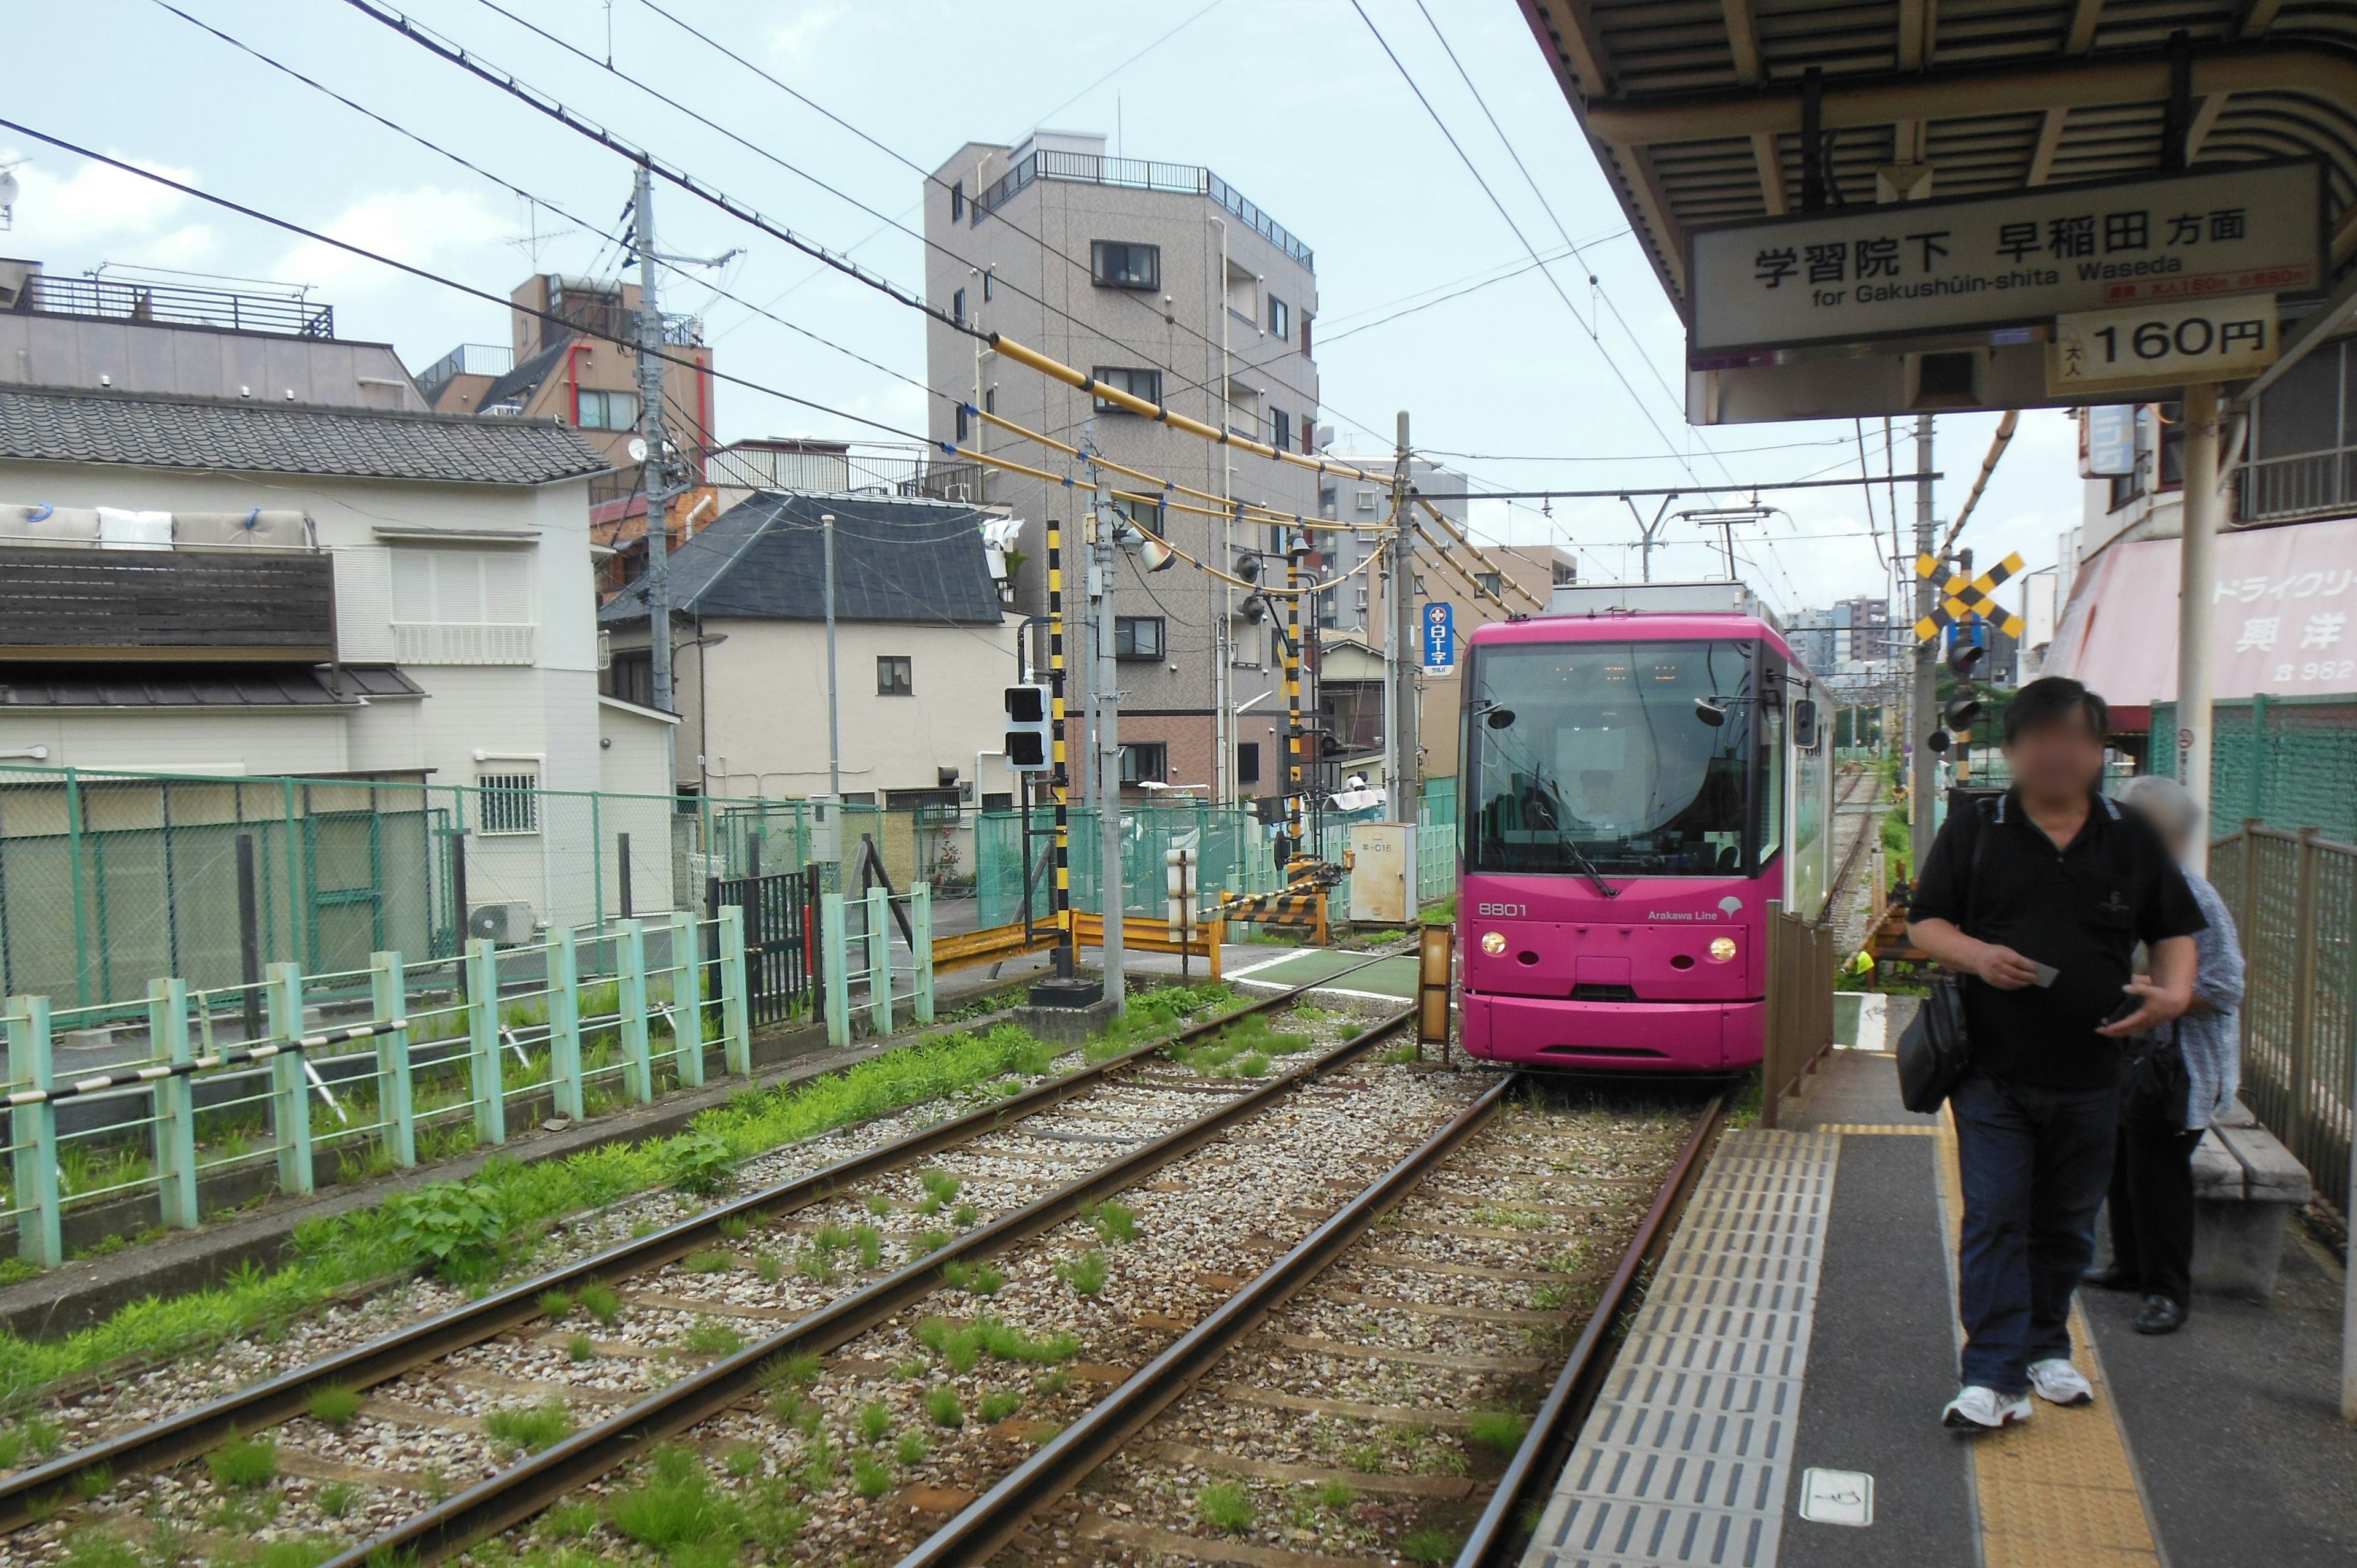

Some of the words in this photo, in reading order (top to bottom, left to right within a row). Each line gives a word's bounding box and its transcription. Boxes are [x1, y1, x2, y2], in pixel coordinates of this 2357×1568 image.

[1755, 231, 1951, 288] 学習院下
[1997, 211, 2149, 262] 早稲田
[2167, 208, 2246, 245] 方面
[1813, 289, 1846, 307] for
[1856, 266, 2059, 303] Gakushūin-shita
[2077, 255, 2182, 282] Waseda
[2095, 317, 2265, 363] 160円
[2213, 569, 2357, 604] ドライクリ
[1431, 624, 1446, 665] 白十字
[1479, 903, 1527, 916] 8801
[1648, 911, 1692, 920] Arakawa
[1695, 911, 1717, 920] Line
